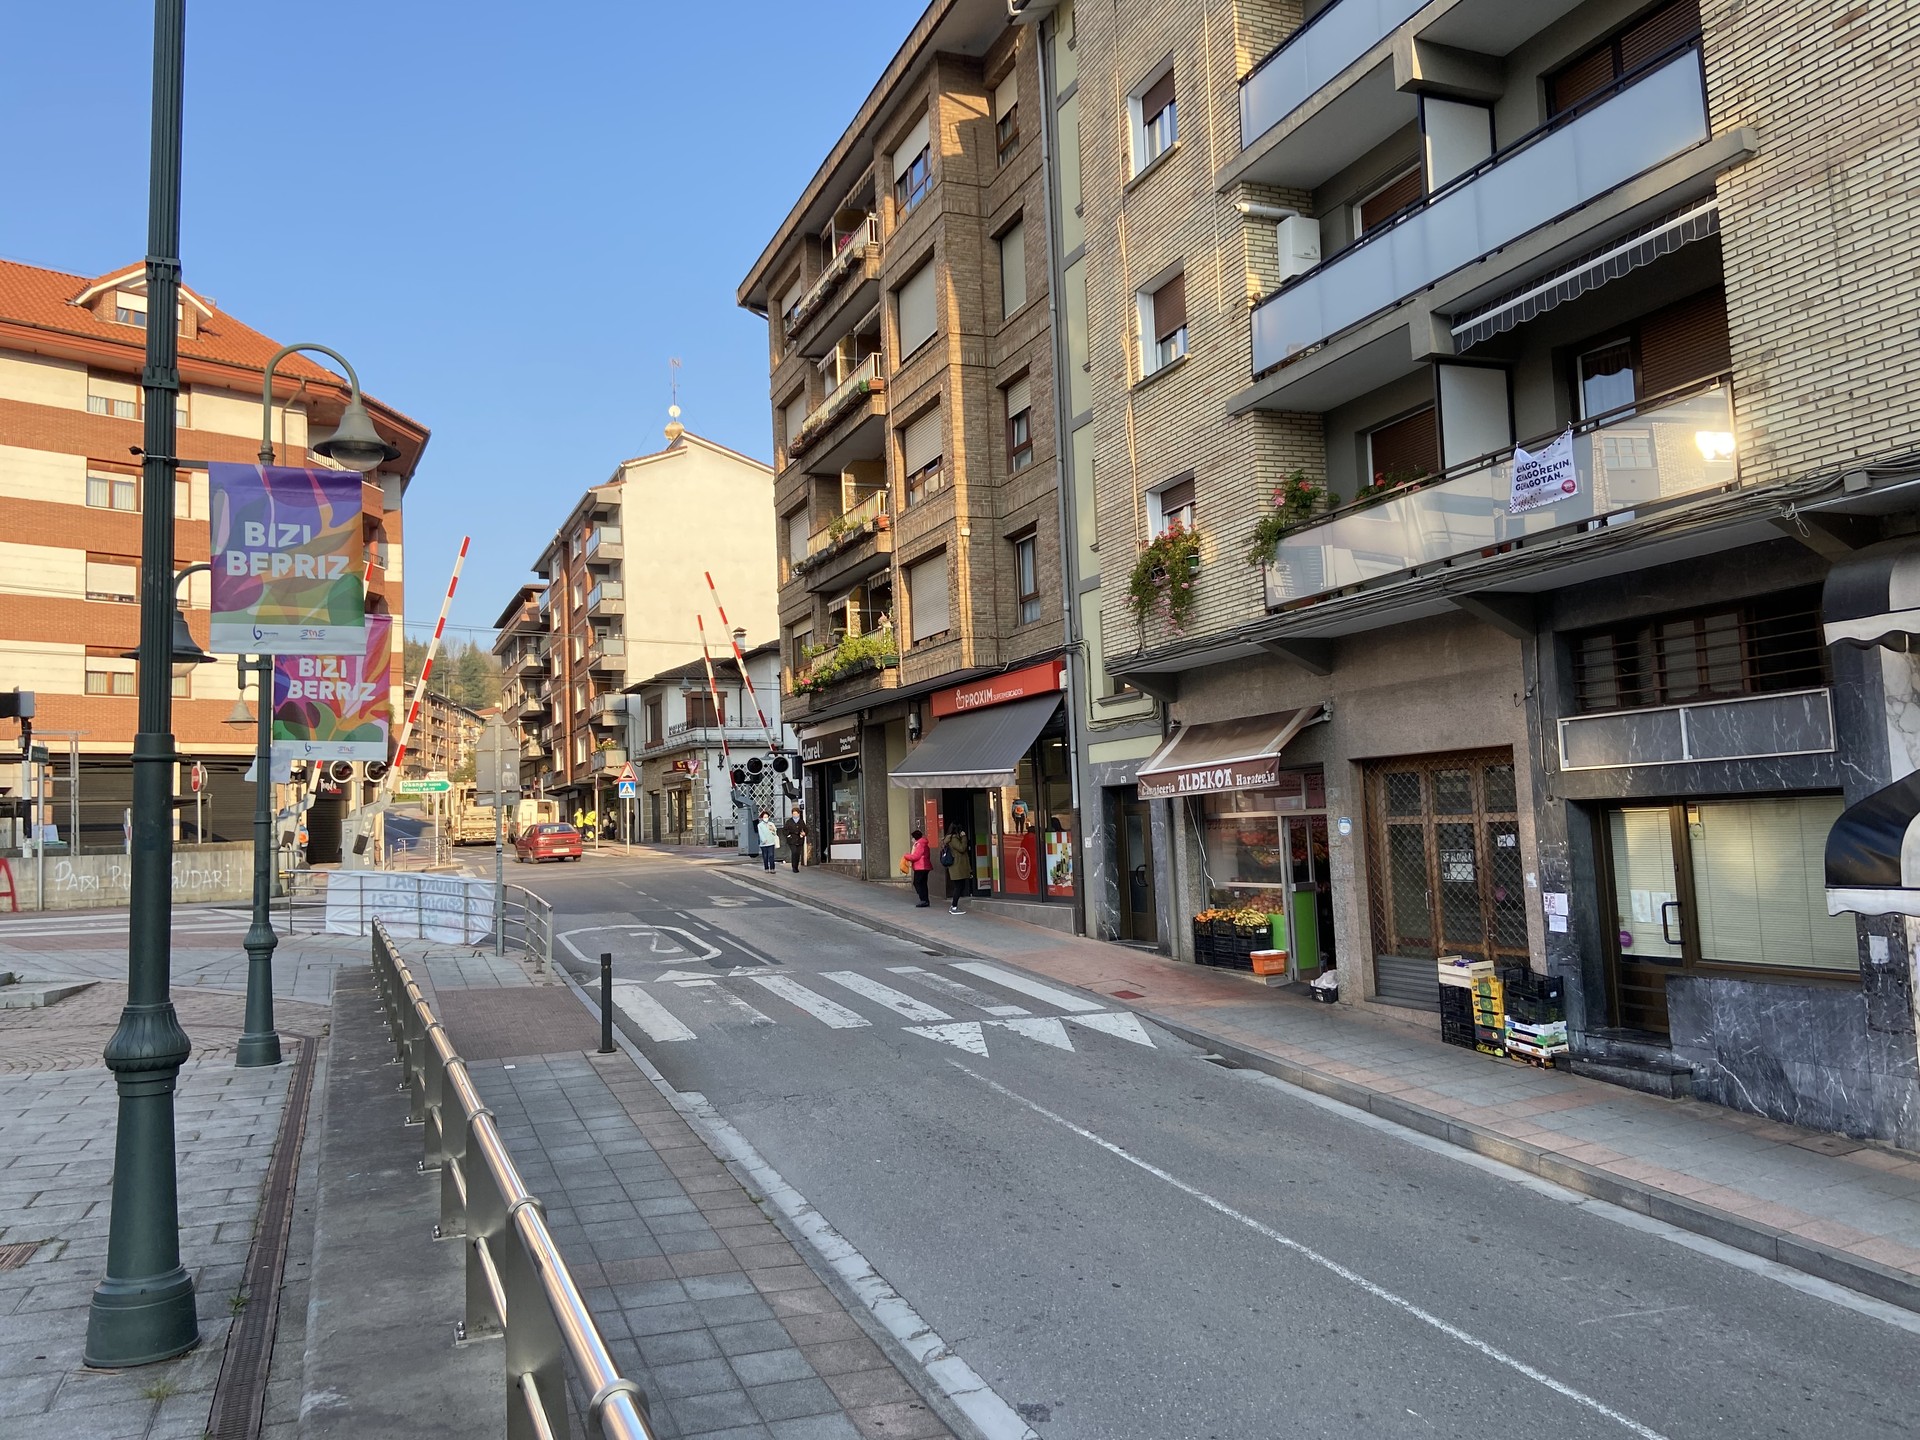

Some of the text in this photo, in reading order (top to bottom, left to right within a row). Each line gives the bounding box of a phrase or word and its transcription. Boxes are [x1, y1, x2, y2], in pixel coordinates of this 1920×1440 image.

[244, 521, 311, 548] BIZI
[226, 550, 350, 580] BERRIZ
[298, 658, 348, 678] BIZI
[287, 679, 377, 701] BERRIZ
[965, 687, 993, 708] PROXIM
[1177, 768, 1233, 792] ALDEKOA
[1236, 771, 1275, 786] Harategia
[54, 860, 100, 893] PATXI
